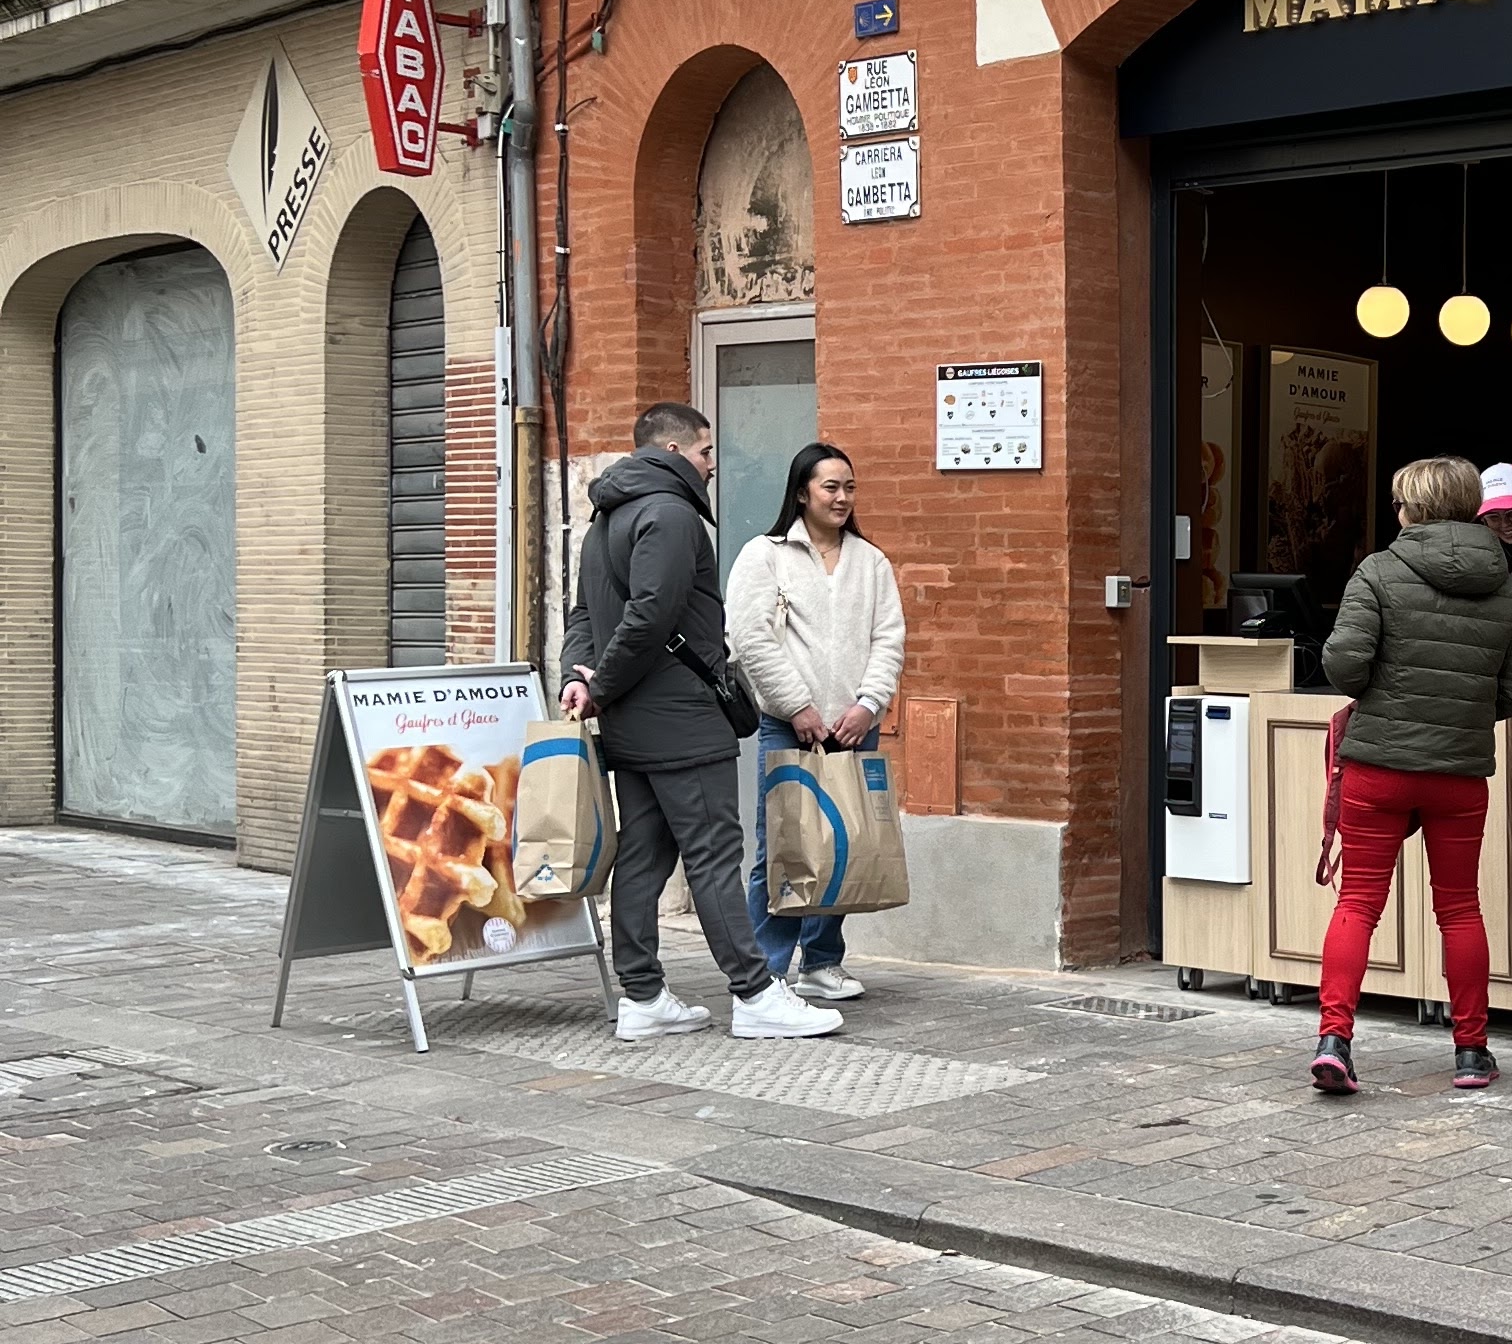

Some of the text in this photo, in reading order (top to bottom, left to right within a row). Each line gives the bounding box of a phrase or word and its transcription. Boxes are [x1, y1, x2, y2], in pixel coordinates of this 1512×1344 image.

[866, 60, 888, 76] RUE
[845, 87, 910, 114] GAMBETTA
[874, 109, 910, 121] POLITIQUE
[268, 126, 326, 263] PRESSE
[847, 181, 912, 207] GAMBETTA
[957, 368, 987, 377] GAUFRES
[1297, 365, 1339, 382] MAMIE
[1289, 384, 1347, 402] D'AMOUR
[353, 685, 529, 707] MAMIE D'AMOUR
[395, 709, 499, 734] Gaufres et Glaces
